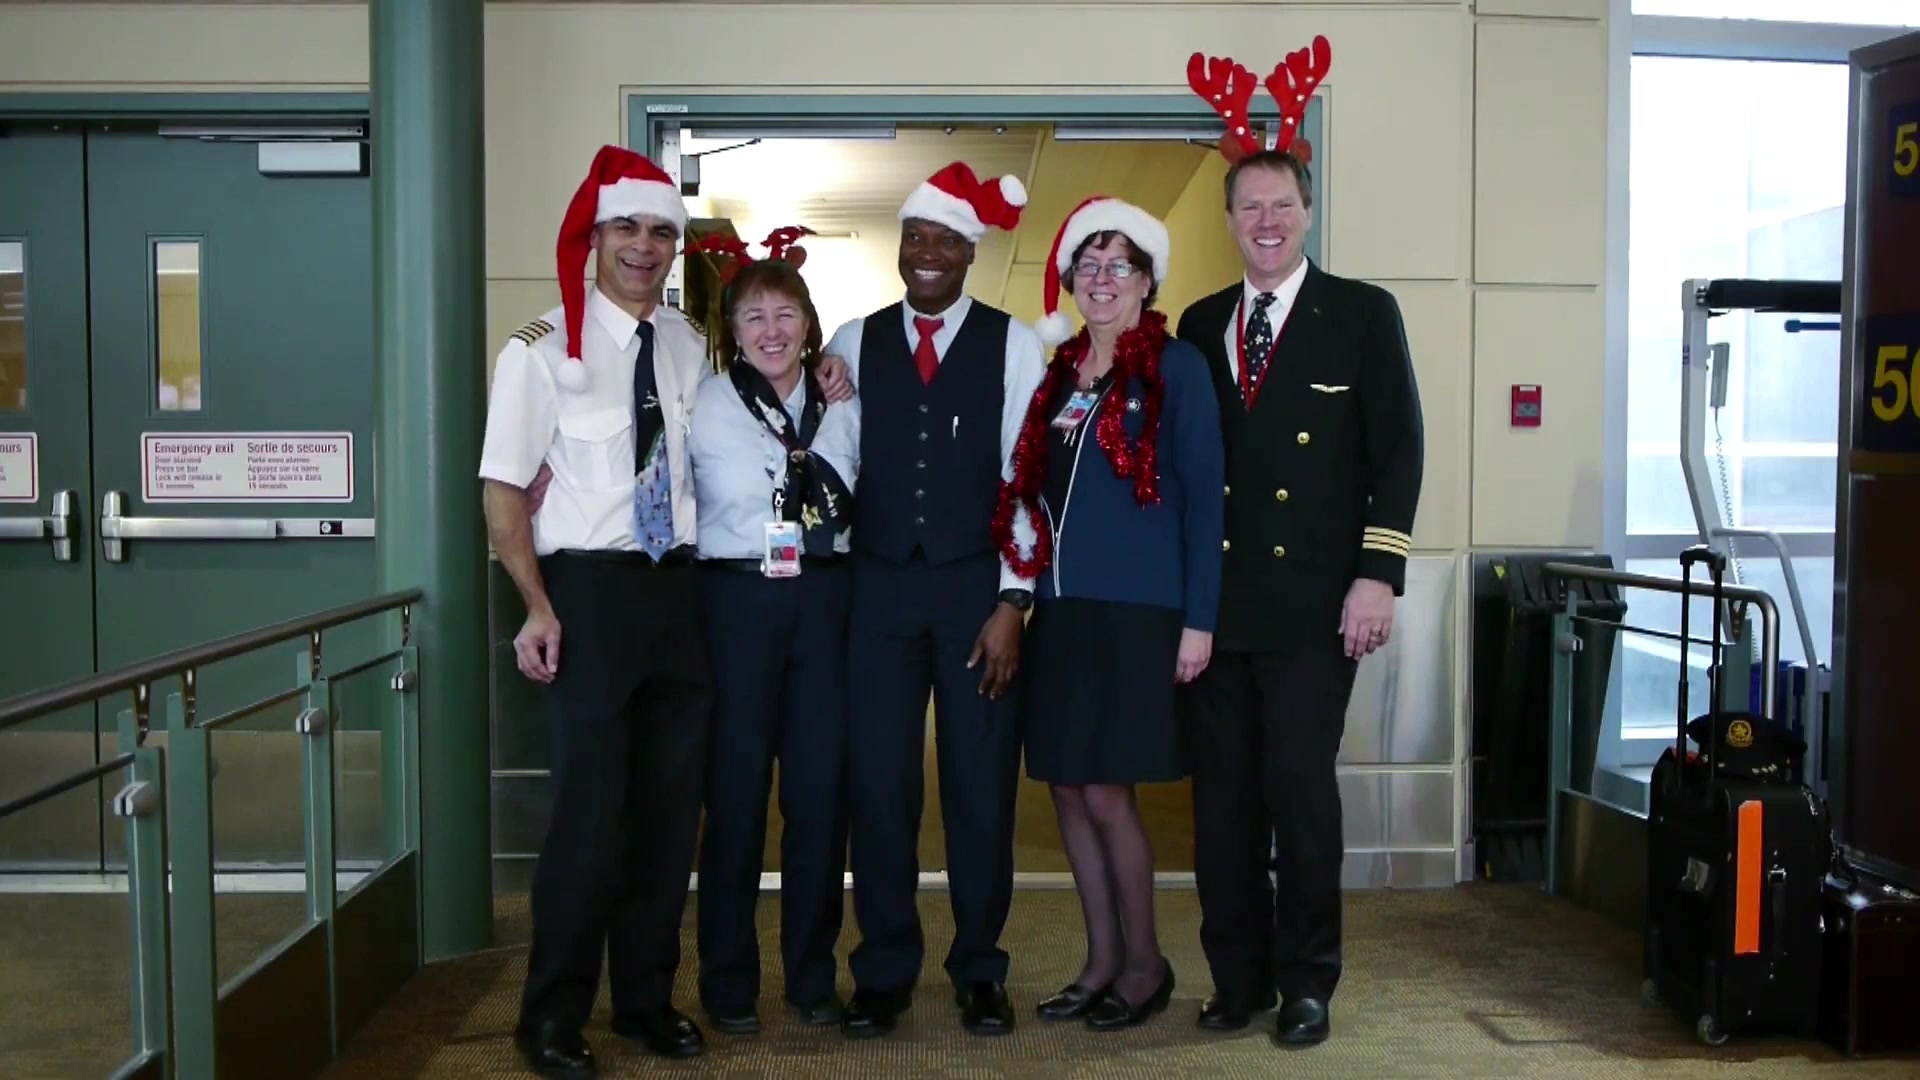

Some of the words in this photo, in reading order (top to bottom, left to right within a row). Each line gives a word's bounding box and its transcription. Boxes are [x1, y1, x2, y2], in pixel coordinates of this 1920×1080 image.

[155, 442, 212, 455] Emergency
[215, 441, 234, 453] exit
[247, 441, 278, 453] Sortie
[281, 441, 294, 453] de
[296, 443, 338, 453] secours
